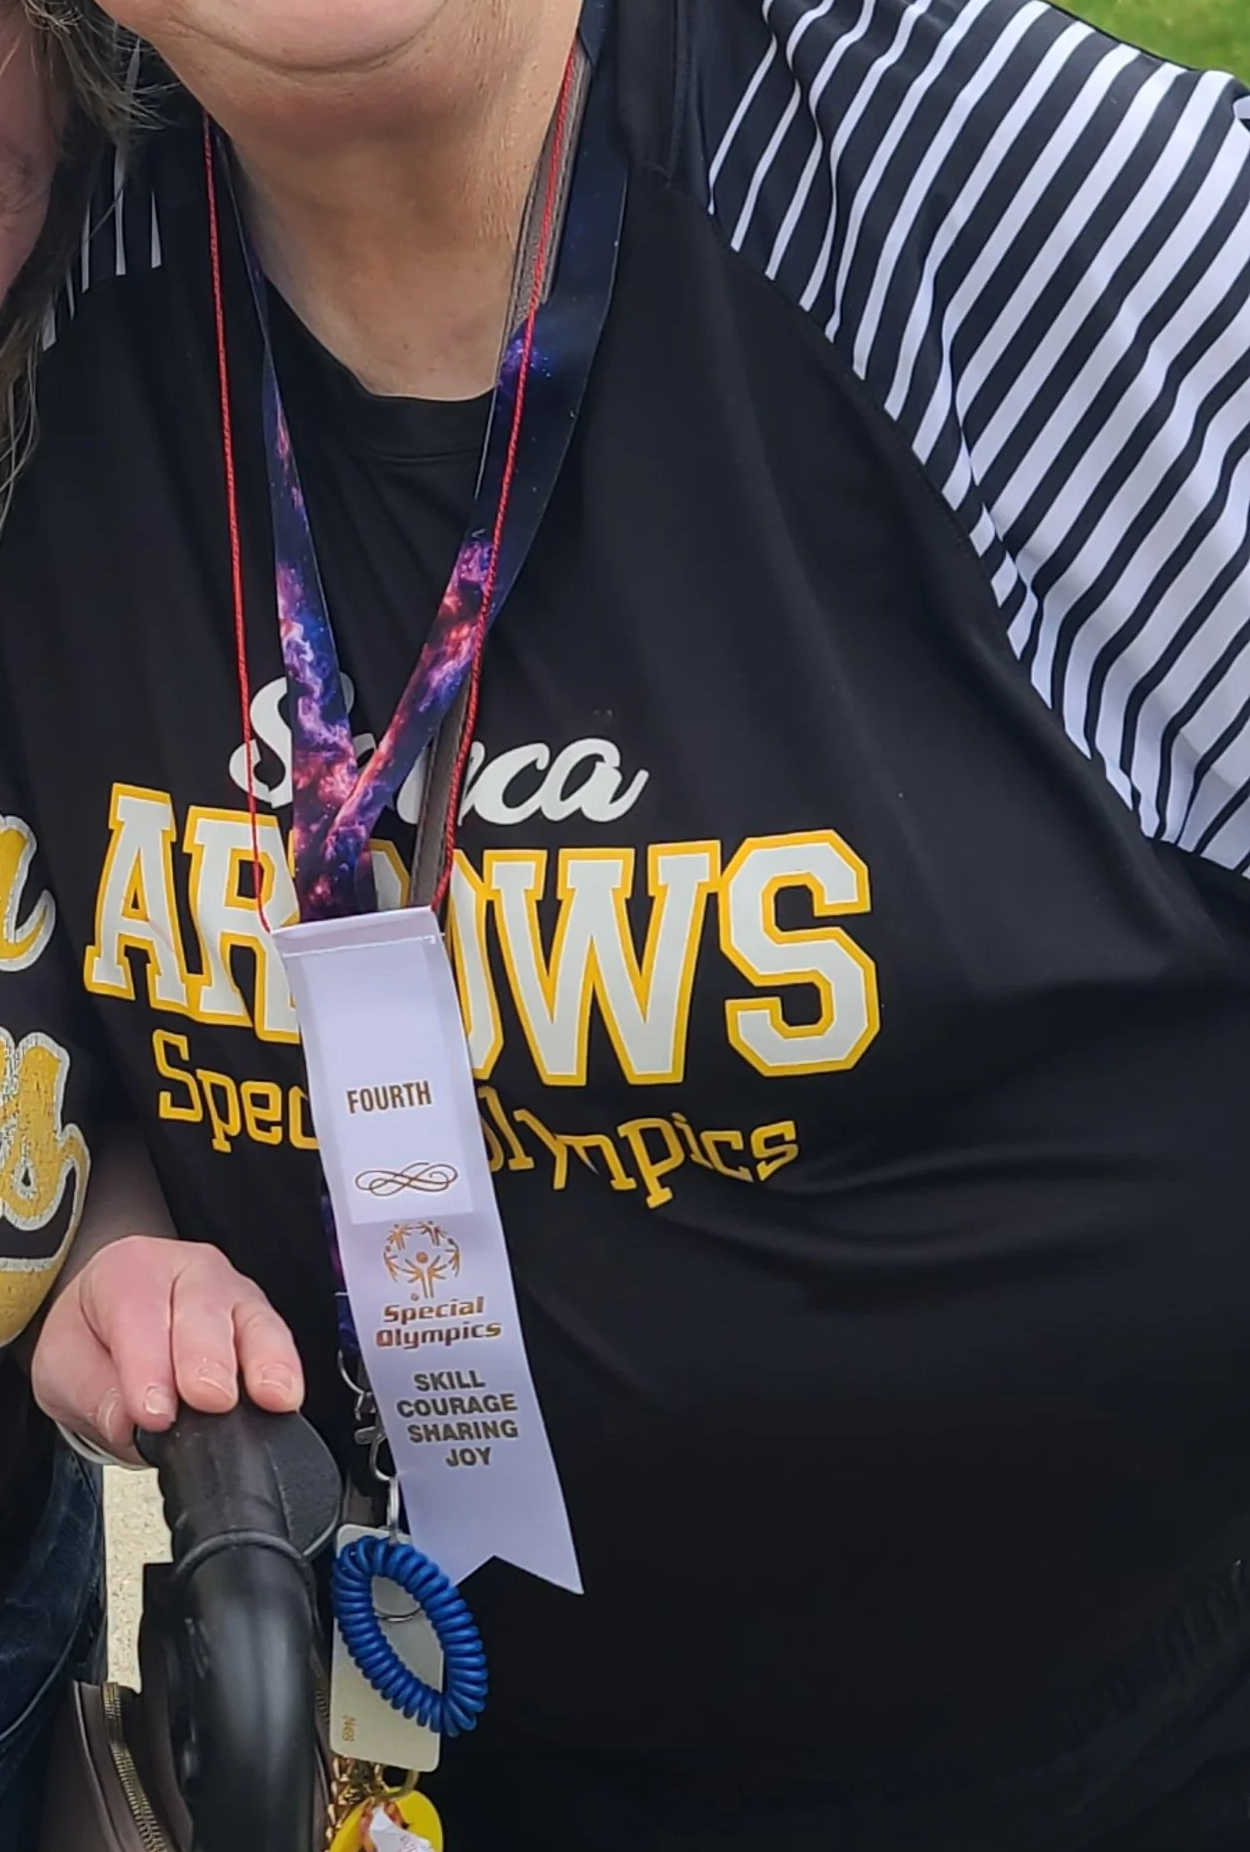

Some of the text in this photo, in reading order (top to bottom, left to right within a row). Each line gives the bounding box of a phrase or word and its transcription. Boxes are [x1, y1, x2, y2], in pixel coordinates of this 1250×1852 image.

[84, 783, 881, 1086] AROWS
[346, 1079, 433, 1114] FOURTH
[152, 1028, 799, 1209] Spec lympics
[383, 1296, 485, 1326] Special
[376, 1321, 502, 1350] Olympics
[413, 1369, 486, 1392] SKILL
[396, 1393, 518, 1418] COURAGE
[407, 1418, 519, 1444] SHARING
[445, 1447, 492, 1468] JOY
